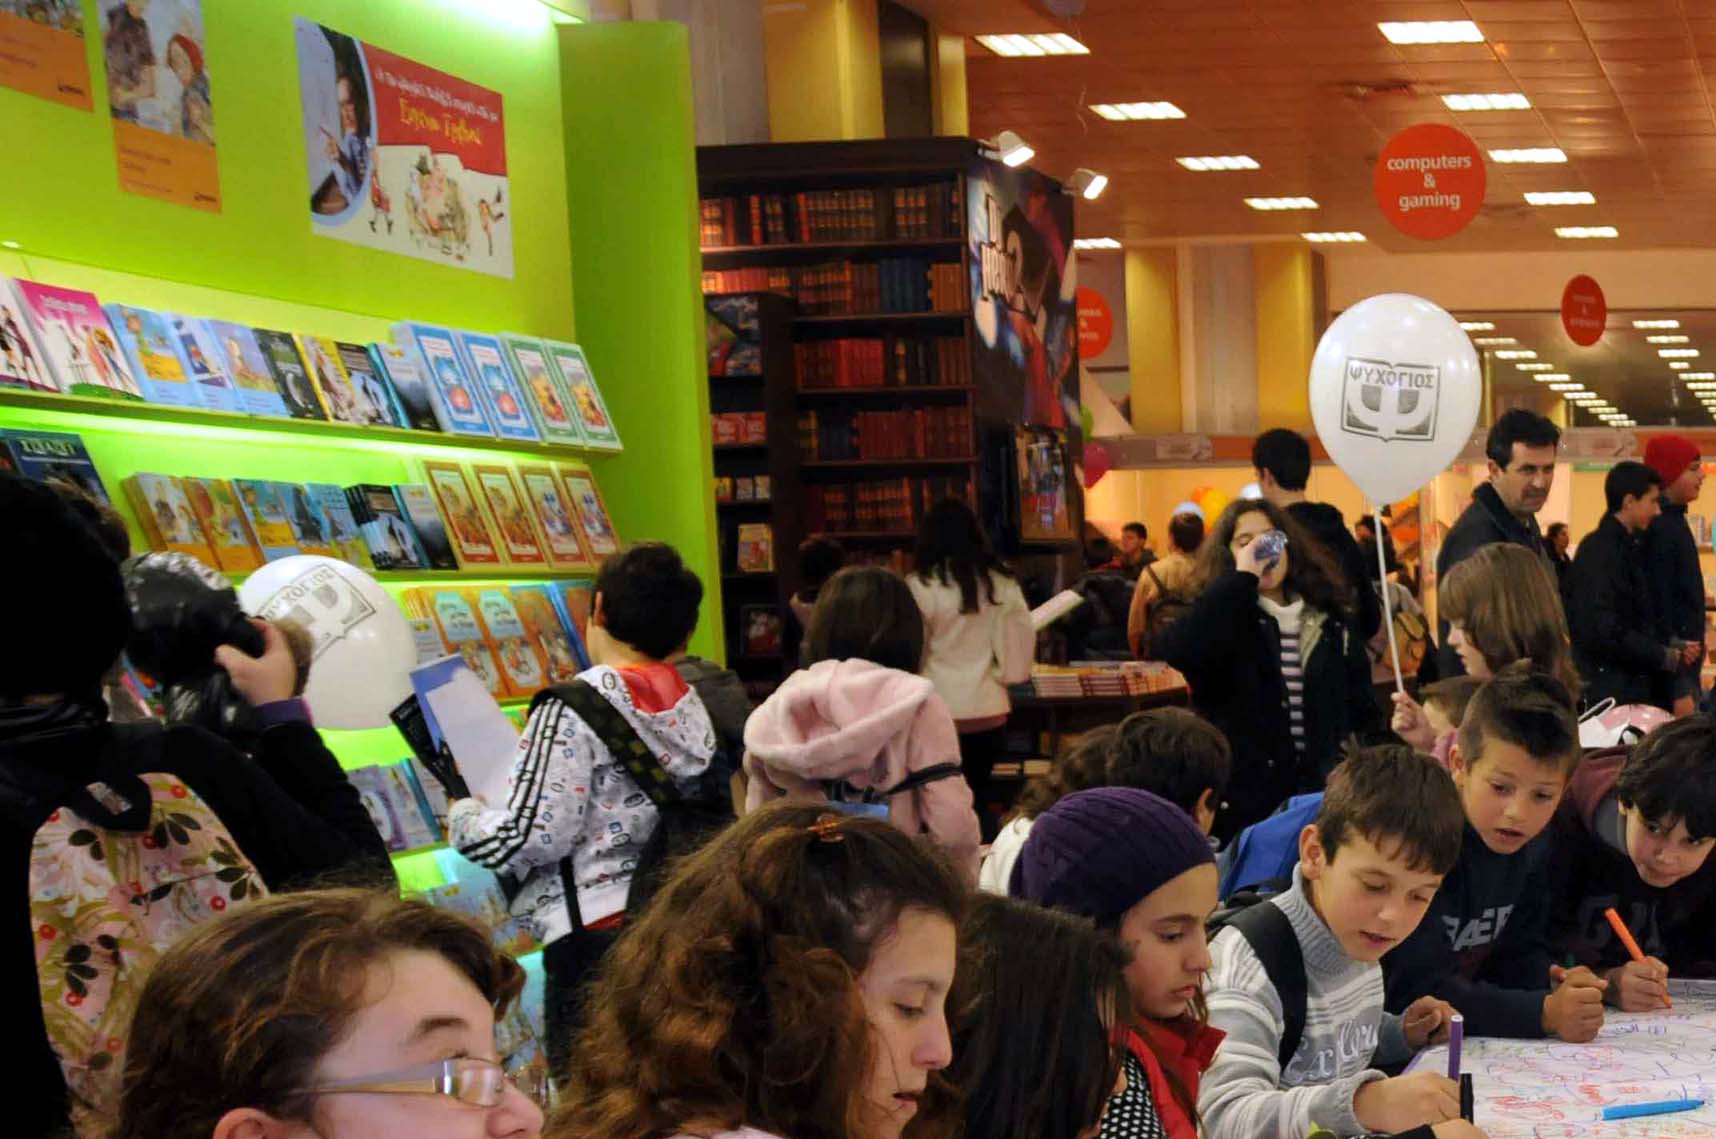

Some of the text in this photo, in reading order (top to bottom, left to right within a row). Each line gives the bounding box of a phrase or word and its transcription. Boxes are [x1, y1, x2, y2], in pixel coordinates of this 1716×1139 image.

[1387, 153, 1472, 171] computers
[1423, 173, 1436, 188] &
[1399, 192, 1460, 211] gaming
[1349, 366, 1435, 390] ΨΥΧΟΓΙΟΣ
